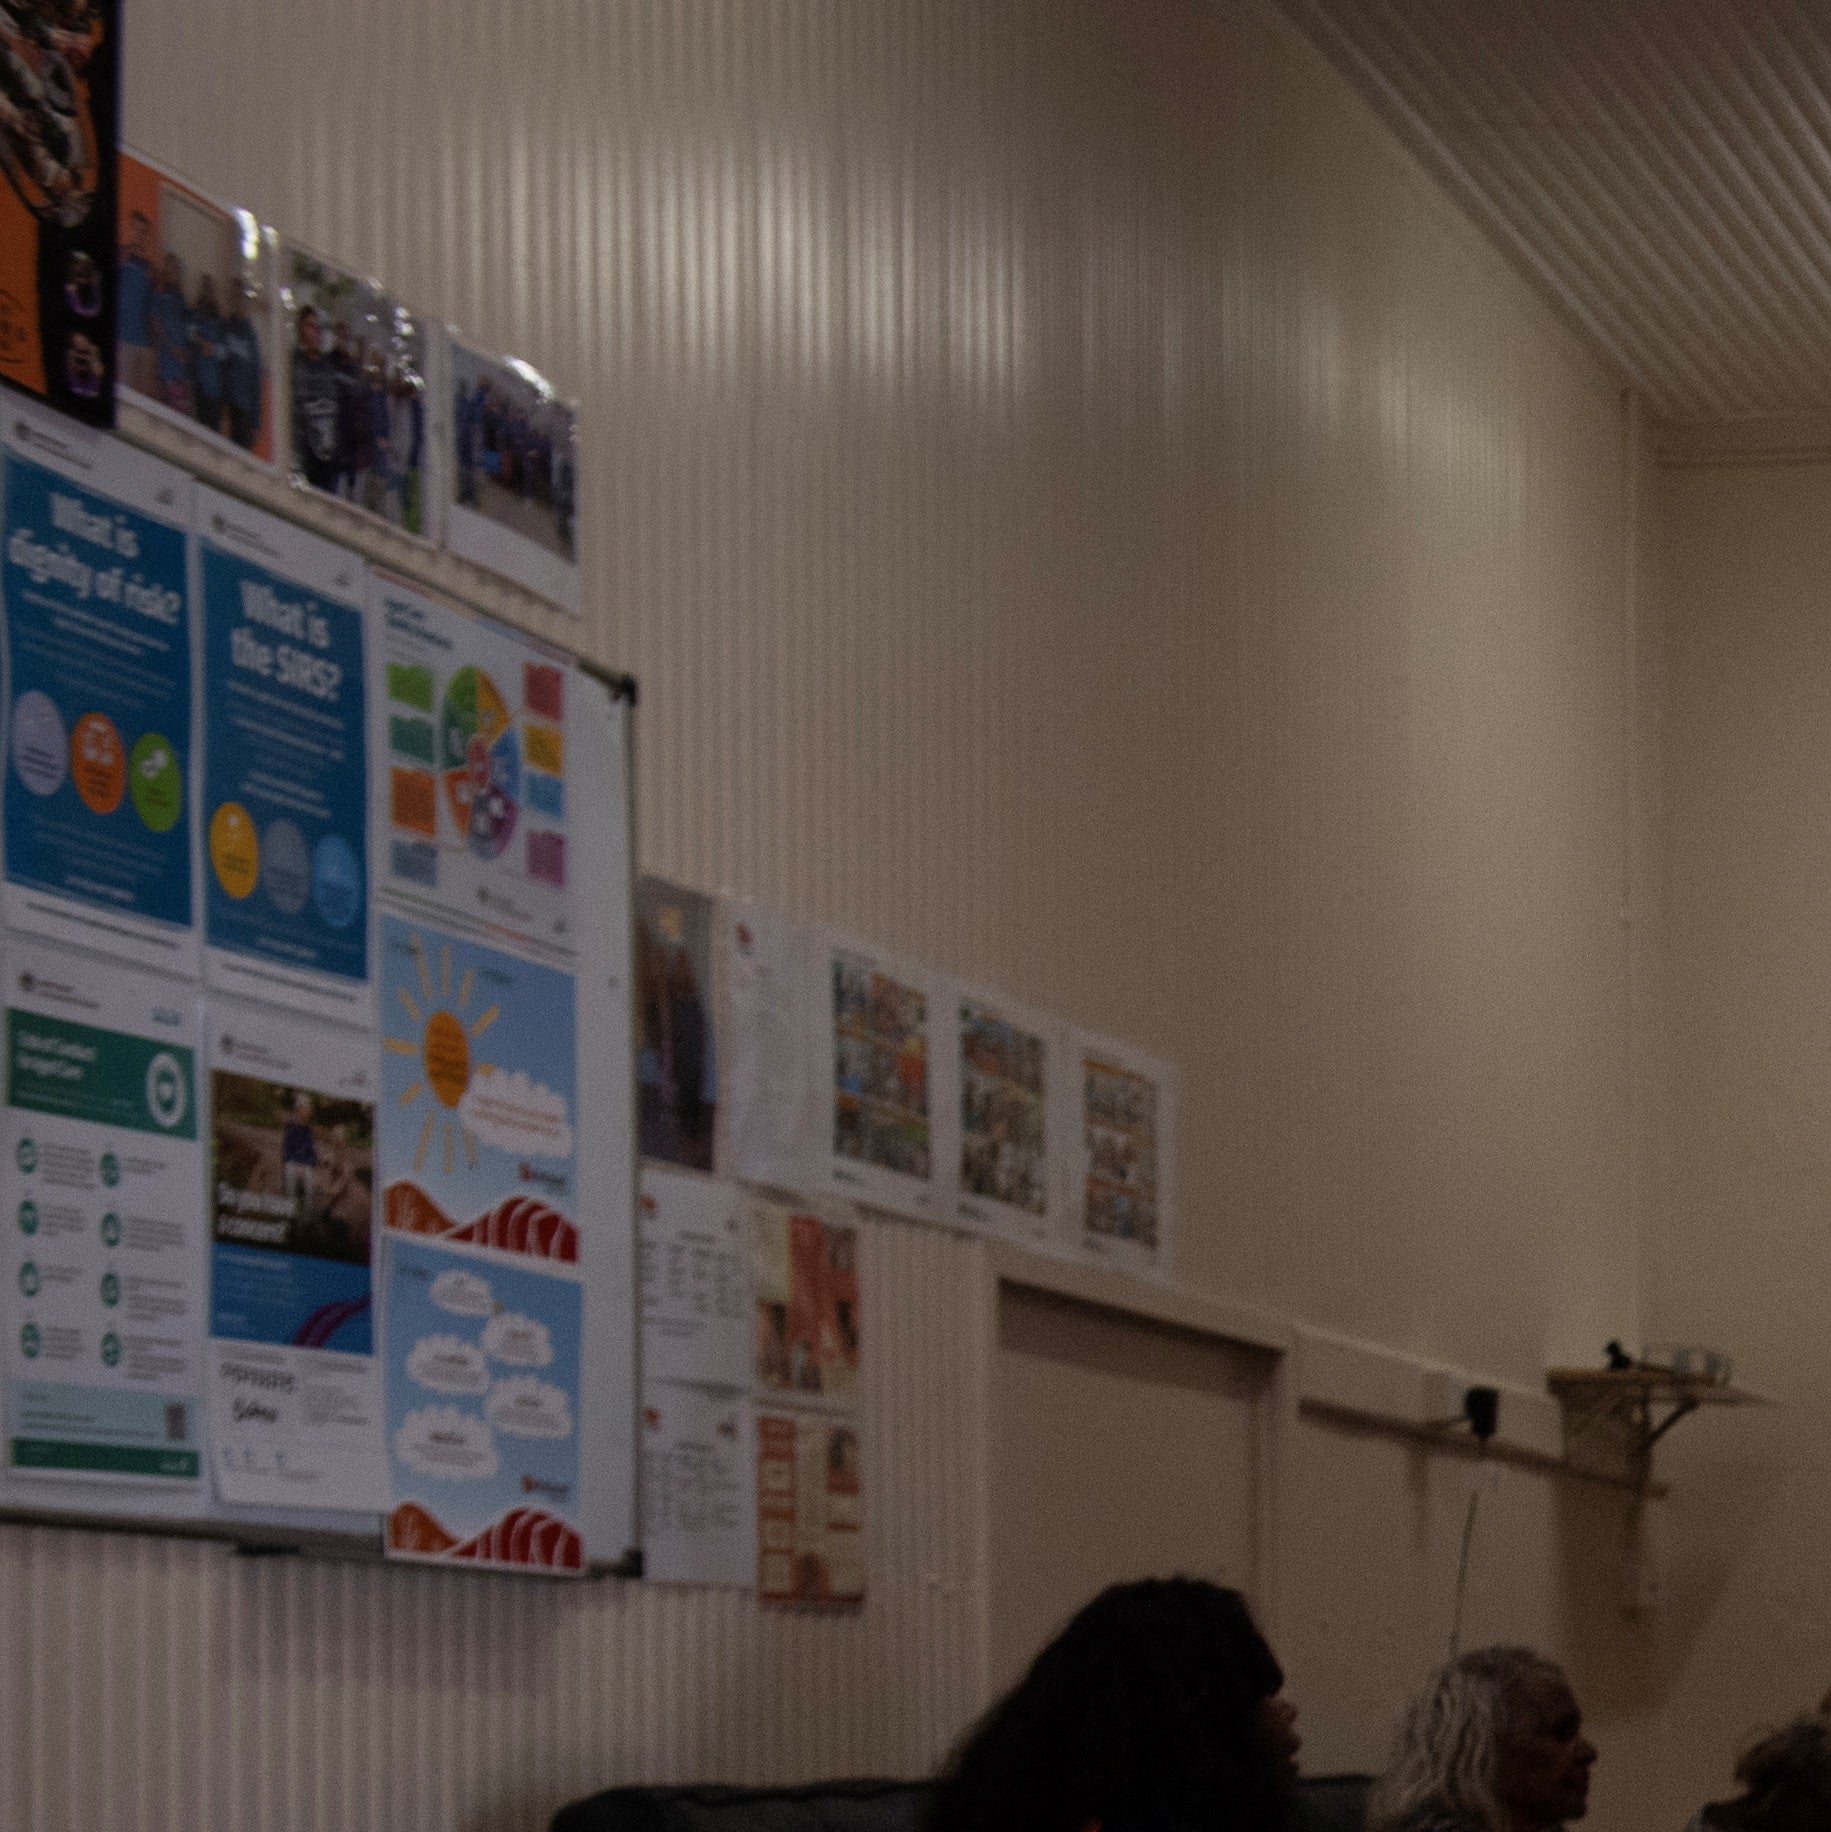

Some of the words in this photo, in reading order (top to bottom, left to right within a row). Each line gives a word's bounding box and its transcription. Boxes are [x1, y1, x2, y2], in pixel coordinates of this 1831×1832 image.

[240, 580, 305, 639] What
[306, 601, 331, 648] is
[230, 626, 273, 676] the
